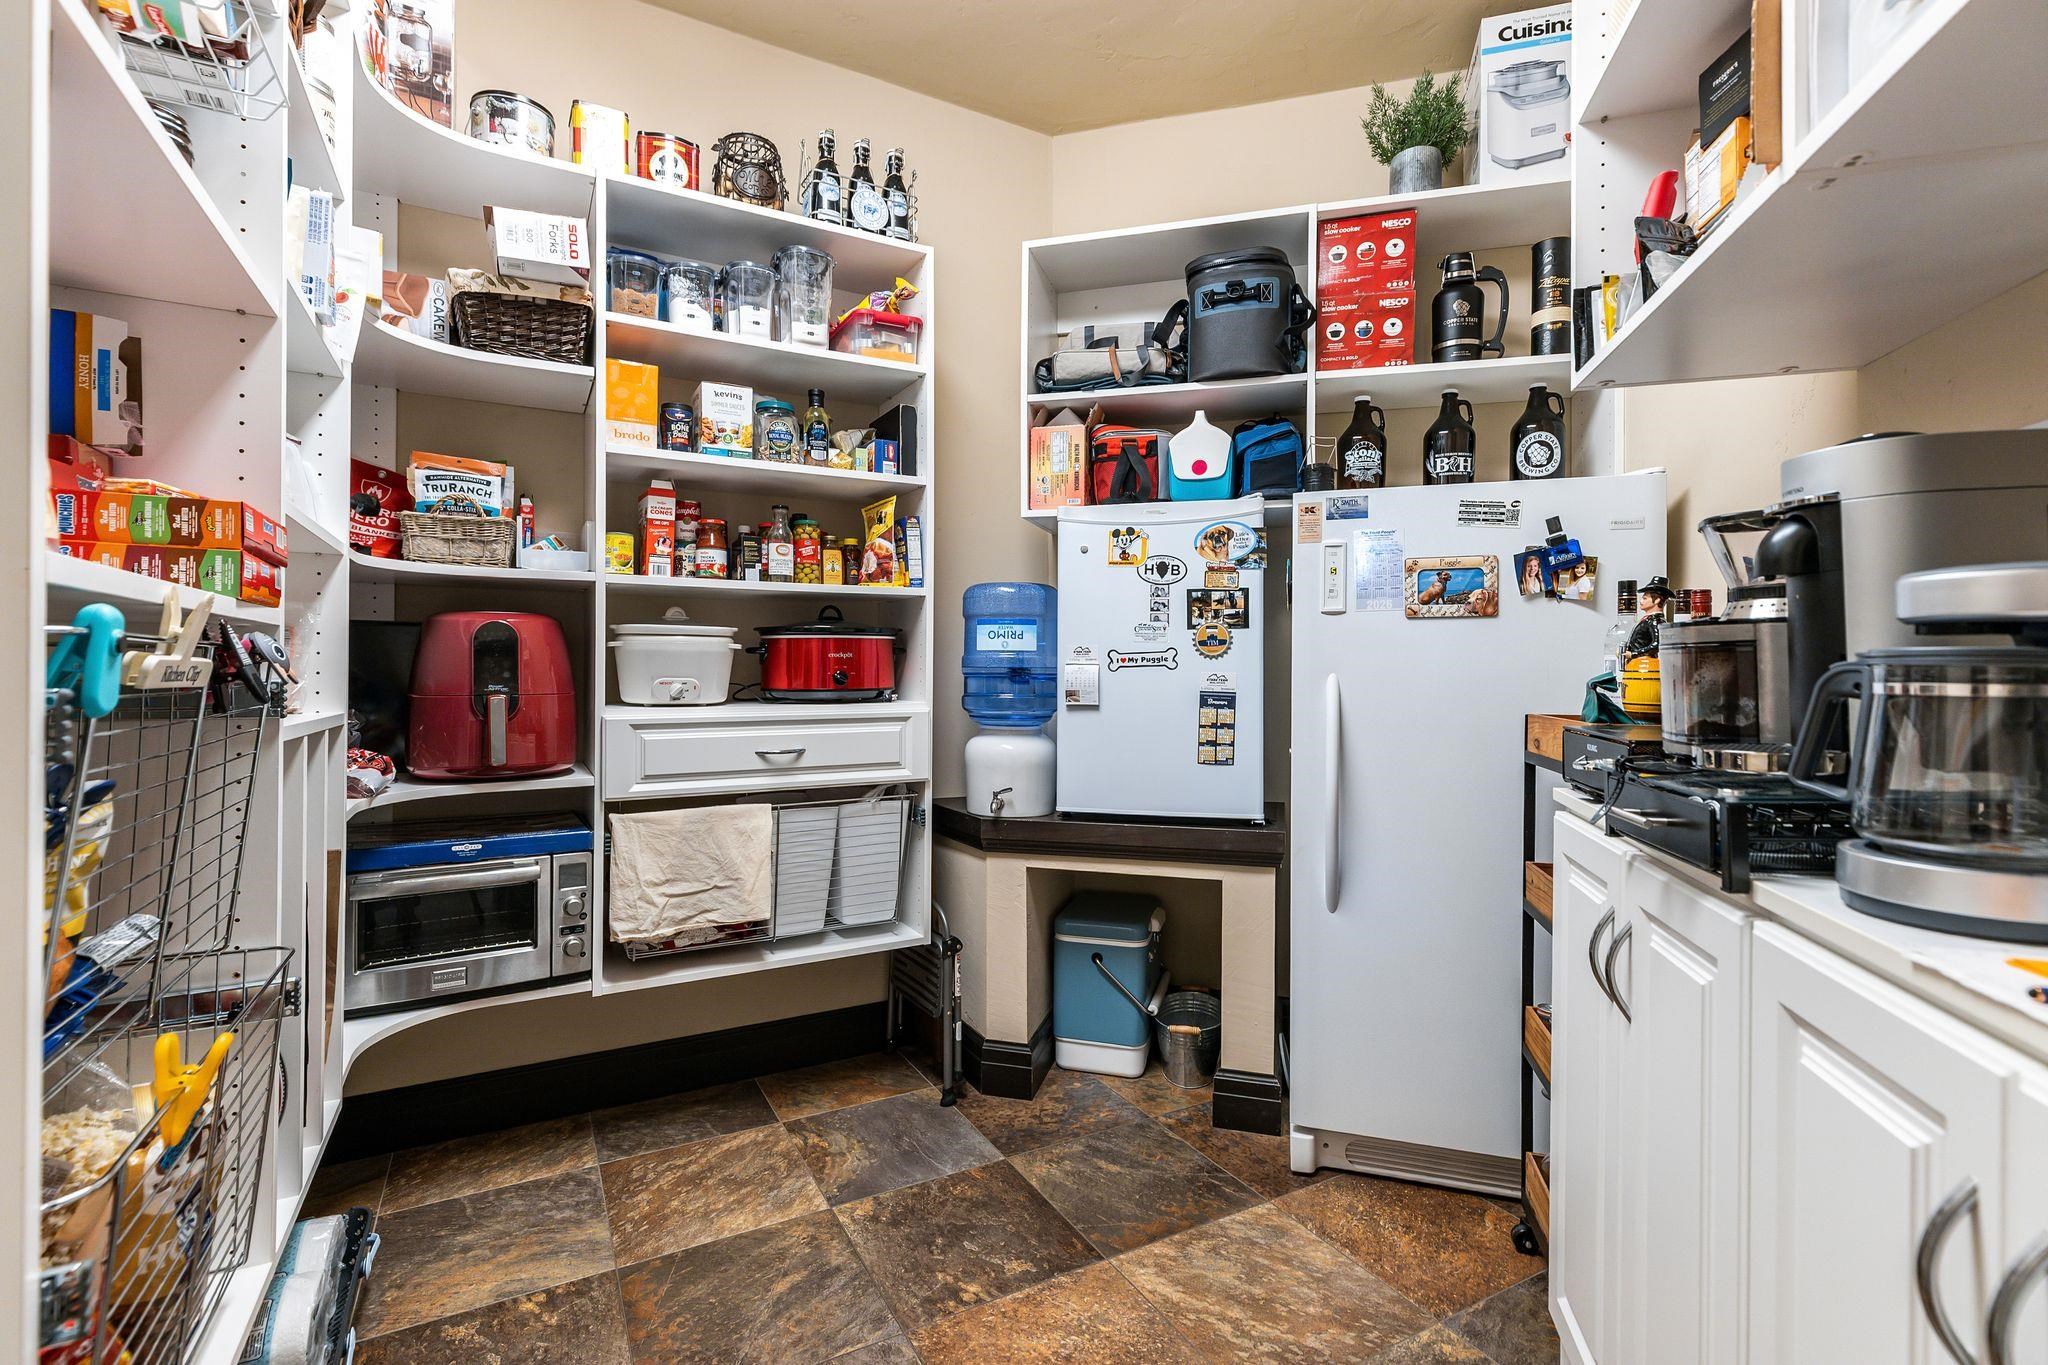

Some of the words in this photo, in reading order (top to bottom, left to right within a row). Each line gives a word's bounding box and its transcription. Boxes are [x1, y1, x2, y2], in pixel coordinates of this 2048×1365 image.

[1381, 218, 1411, 228] NESCO
[549, 223, 559, 254] Forks
[568, 224, 579, 259] SOLO
[1379, 298, 1409, 307] NESCO
[78, 354, 90, 389] HONEY
[714, 390, 743, 400] kevins
[614, 428, 650, 442] brodo
[1519, 434, 1542, 453] COPPER
[1544, 435, 1559, 449] STATE
[1519, 459, 1550, 474] BREWING
[454, 475, 487, 485] ALTERNATIVE
[109, 503, 117, 516] BUTTER
[181, 508, 189, 521] BUTTER
[99, 509, 109, 525] Real
[172, 514, 181, 528] Real
[109, 517, 117, 532] PEANUT
[181, 521, 189, 536] PEANUT
[351, 524, 399, 540] BLANKET
[1144, 564, 1154, 575] H
[1171, 564, 1180, 575] B
[1439, 558, 1461, 567] Puggle
[988, 630, 1024, 640] PRIMO
[1127, 657, 1139, 665] My
[1141, 655, 1169, 664] Puggle
[160, 664, 186, 683] Kitchen
[186, 664, 202, 686] Clip
